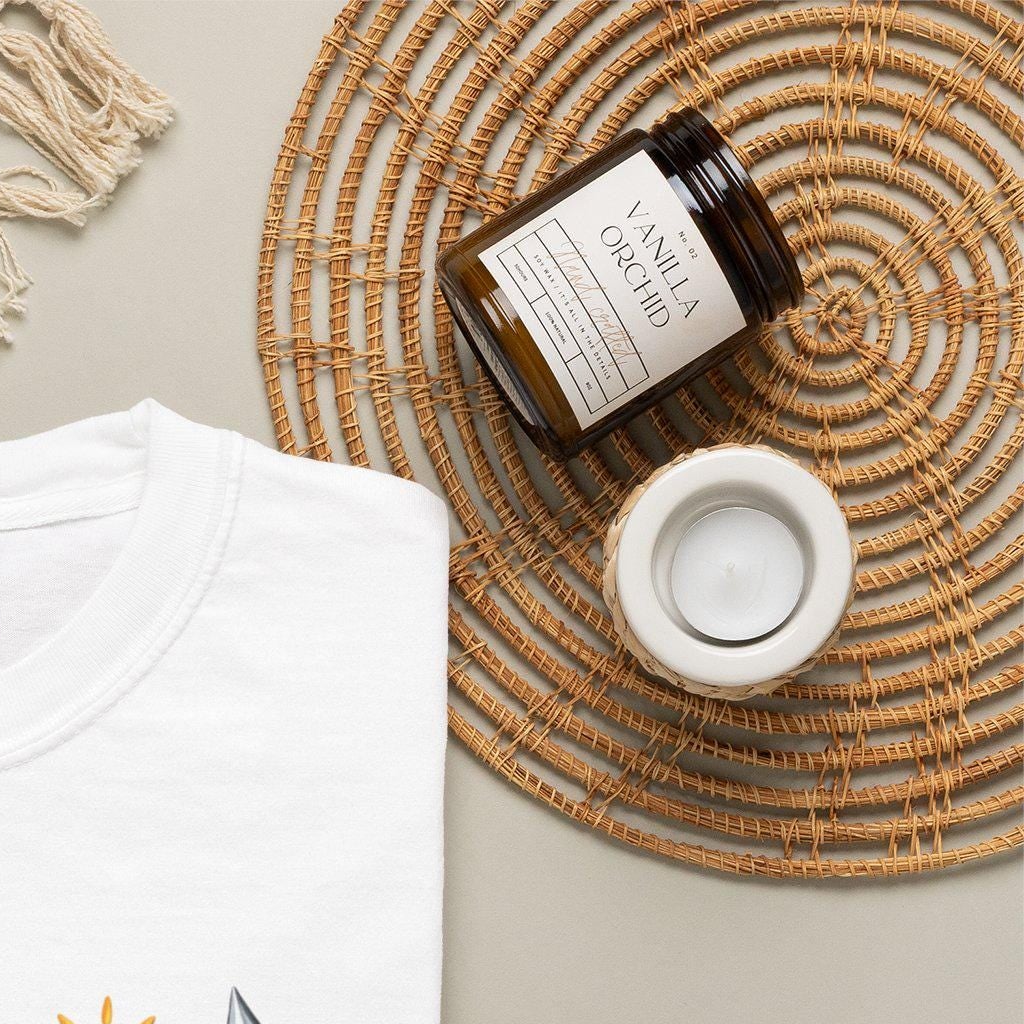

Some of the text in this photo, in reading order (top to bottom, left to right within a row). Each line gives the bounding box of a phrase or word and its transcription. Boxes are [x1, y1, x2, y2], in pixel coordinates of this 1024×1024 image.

[600, 225, 670, 328] ORCHID
[626, 200, 700, 318] VANILLA
[688, 248, 698, 260] 02
[533, 254, 544, 268] SOY
[543, 269, 555, 284] WAX
[568, 309, 581, 322] ALL
[578, 324, 586, 333] IN
[584, 336, 596, 349] THE
[593, 351, 611, 381] DETAILS
[553, 324, 568, 345] NATURAL
